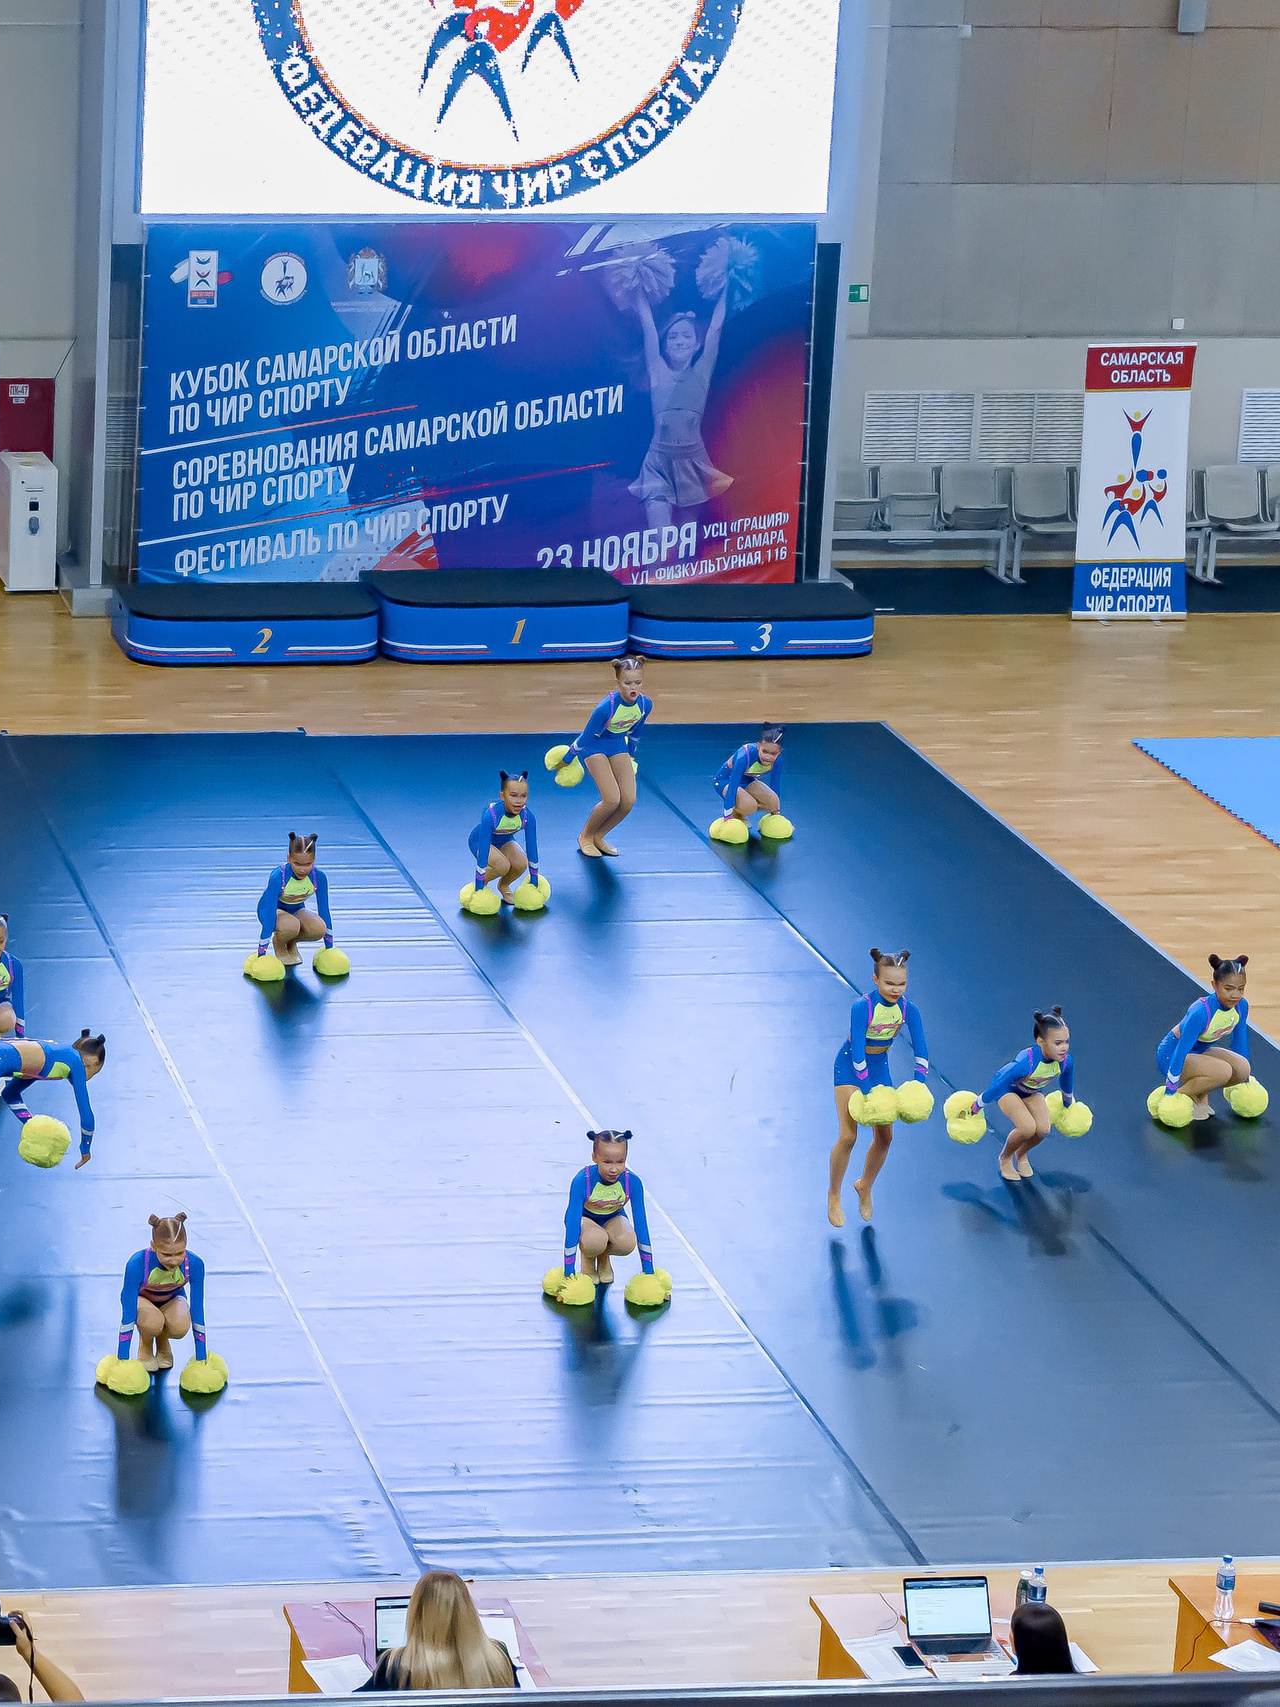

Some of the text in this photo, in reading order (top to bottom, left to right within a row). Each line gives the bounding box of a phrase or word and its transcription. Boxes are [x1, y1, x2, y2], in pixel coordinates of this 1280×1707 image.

[284, 56, 719, 209] ФЕДЕРАЦИЯ ЧИР СПОРТА
[170, 314, 517, 401] КУБОК САМАРСКОЙ ОБЛАСТИ
[1100, 351, 1184, 366] САМАРСКАЯ
[1110, 369, 1171, 384] ОБЛАСТЬ
[169, 376, 353, 435] ПО ЧИР СПОРТУ
[173, 385, 624, 490] СОРЕВНОВАНИЯ САМАРСКОЙ ОБЛАСТИ
[173, 463, 355, 522] ПО ЧИР СПОРТУ
[174, 494, 510, 577] ФЕСТИВАЛЬ ПО ЧИР СПОРТУ
[703, 511, 789, 539] УСЦ «ГРАЦИЯ»
[536, 522, 697, 571] 23 НОЯБРЯ
[724, 530, 788, 553] Г. САМАРА,
[655, 552, 765, 582] ФИЗКУЛЬТУРНАЯ,
[766, 546, 788, 564] 116
[1090, 567, 1171, 591] ФЕДЕРАЦИЯ
[1086, 595, 1171, 612] ЧИР СПОРТА
[251, 629, 273, 655] 2
[508, 619, 526, 644] 1
[750, 623, 773, 651] 3
